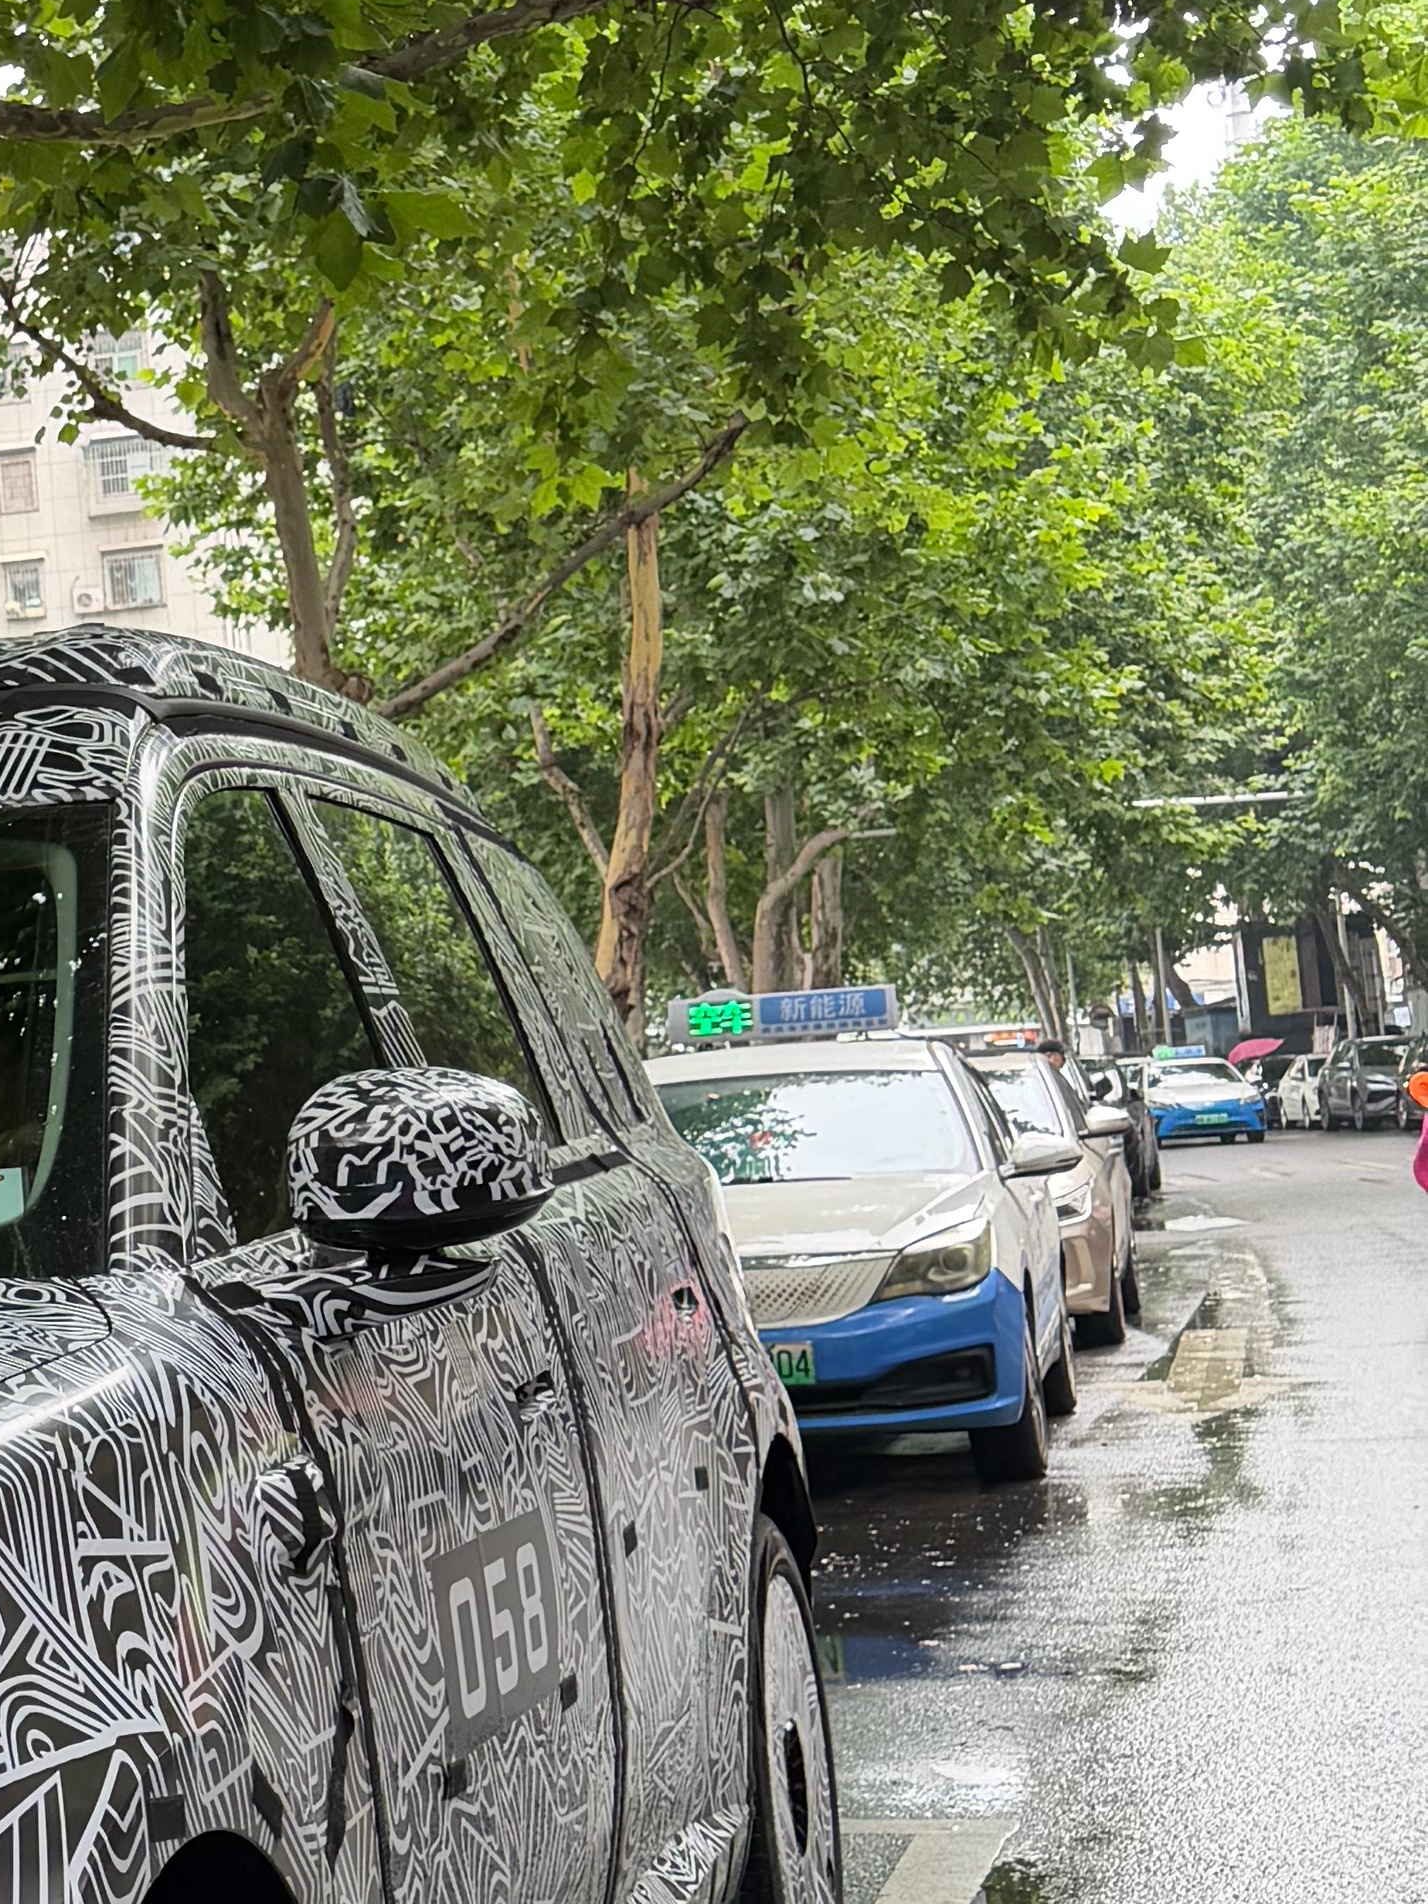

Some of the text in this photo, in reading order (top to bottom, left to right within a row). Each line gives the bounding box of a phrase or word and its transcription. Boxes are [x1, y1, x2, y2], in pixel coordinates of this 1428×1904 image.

[780, 992, 867, 1022] 新能源
[447, 1539, 551, 1721] 058
